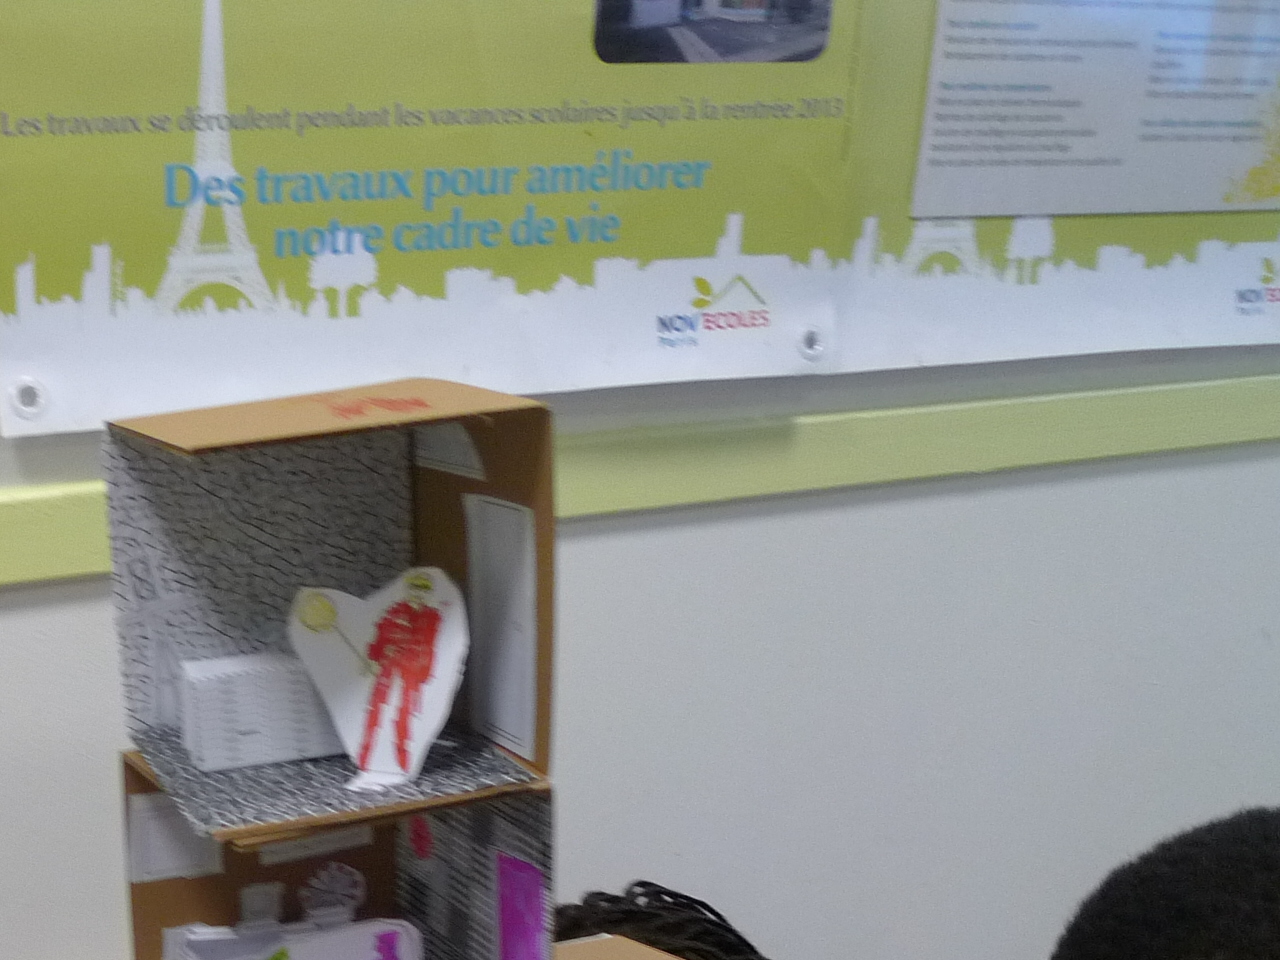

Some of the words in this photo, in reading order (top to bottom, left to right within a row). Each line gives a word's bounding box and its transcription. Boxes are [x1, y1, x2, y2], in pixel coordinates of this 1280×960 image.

[0, 110, 43, 136] Les
[47, 112, 142, 136] travaux
[148, 113, 172, 133] se
[296, 102, 391, 137] pendant
[164, 163, 247, 209] Des
[254, 166, 413, 206] travaux
[424, 166, 518, 212] pour
[524, 149, 711, 196] améliorer
[275, 218, 385, 259] notre
[392, 207, 502, 253] cadre
[509, 203, 557, 247] de
[564, 202, 621, 244] vie
